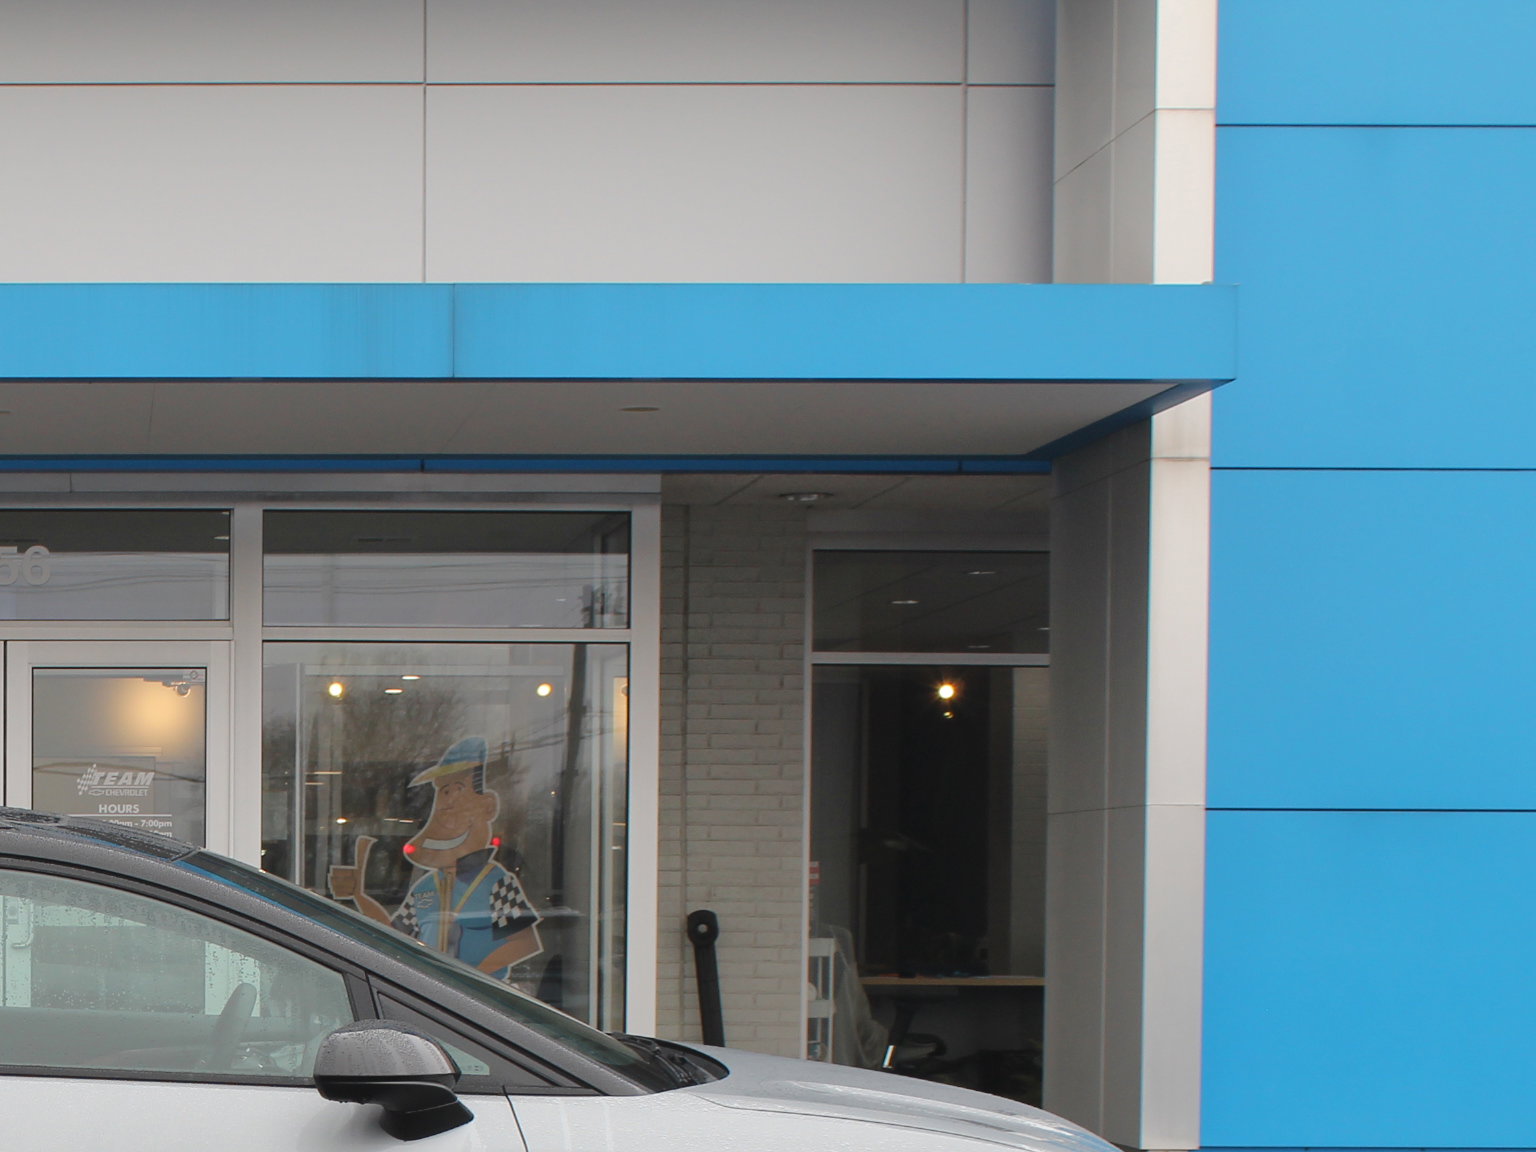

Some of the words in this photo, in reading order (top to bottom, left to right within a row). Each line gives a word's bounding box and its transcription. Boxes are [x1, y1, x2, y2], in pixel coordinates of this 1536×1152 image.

[91, 772, 155, 786] TEAM
[105, 789, 148, 797] CHEVROLET
[98, 804, 140, 814] HOURS
[140, 820, 172, 829] 7:00pm
